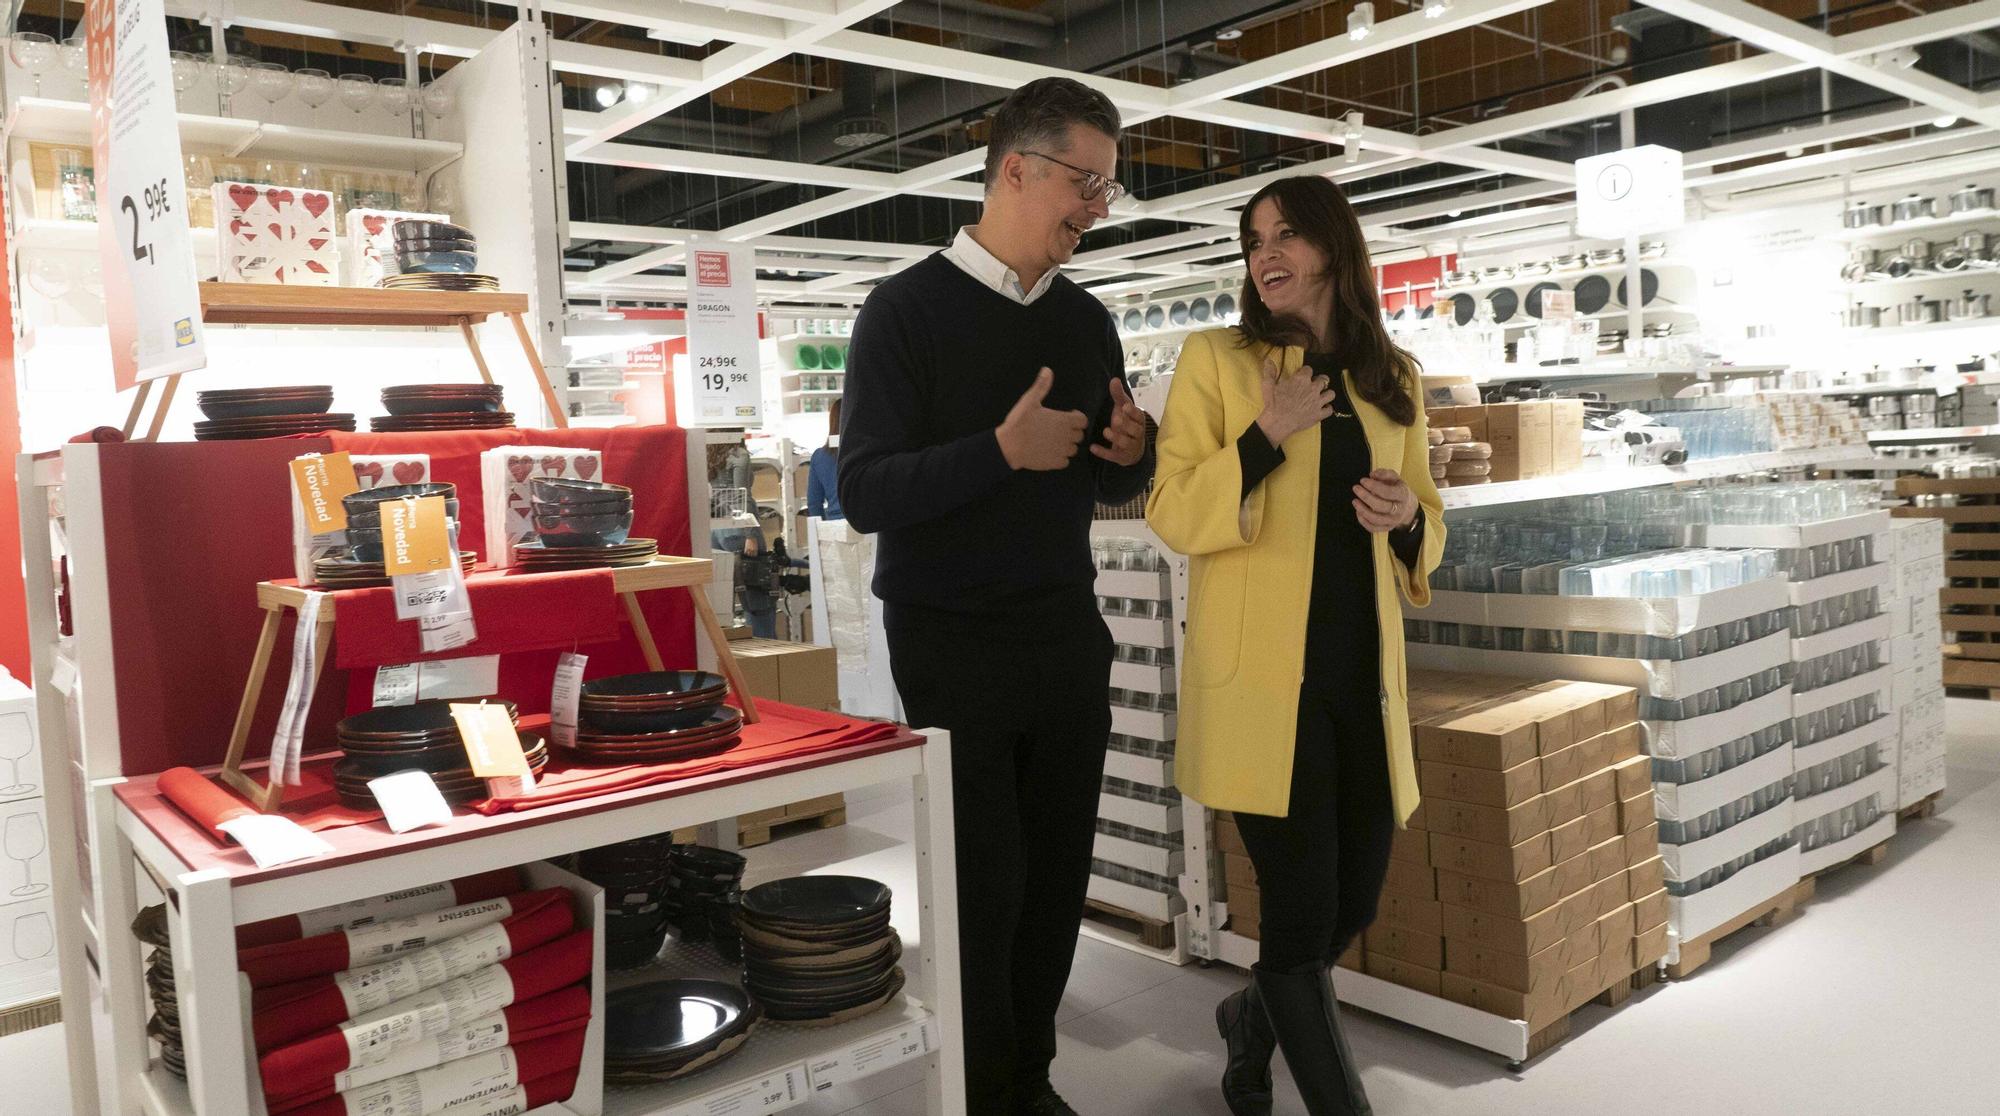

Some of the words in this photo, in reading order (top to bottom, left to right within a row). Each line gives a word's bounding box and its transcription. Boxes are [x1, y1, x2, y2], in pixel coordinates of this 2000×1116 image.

[699, 255, 721, 263] Hemos
[699, 356, 737, 368] 24,99€
[304, 464, 333, 522] Novedad
[392, 508, 412, 565] Novedad
[384, 884, 446, 902] VINTERFINT
[438, 903, 503, 923] VINTERFINT
[442, 1082, 509, 1109] VINTERFINT
